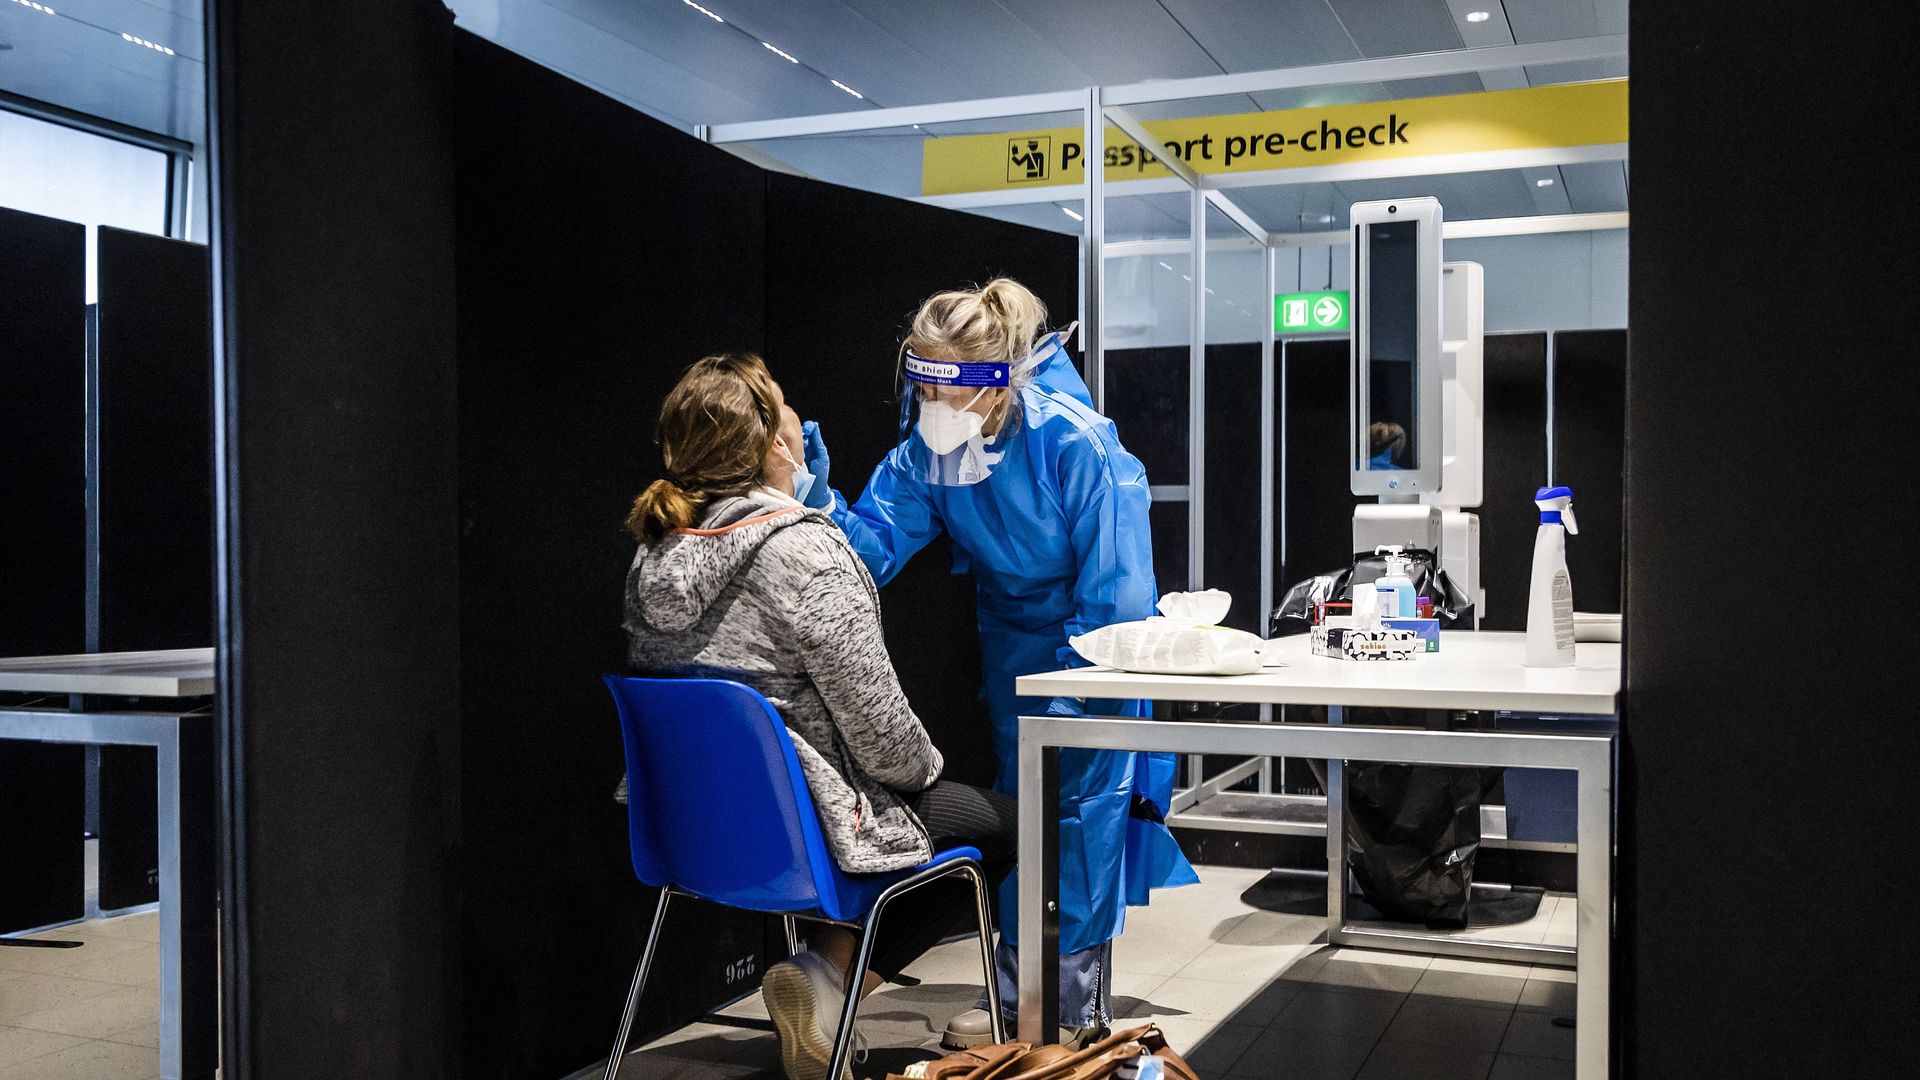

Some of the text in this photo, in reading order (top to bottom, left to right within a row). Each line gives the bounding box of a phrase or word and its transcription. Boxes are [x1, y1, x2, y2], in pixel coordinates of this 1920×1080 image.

[1061, 114, 1409, 172] Pssport pre-check
[921, 365, 953, 376] shield
